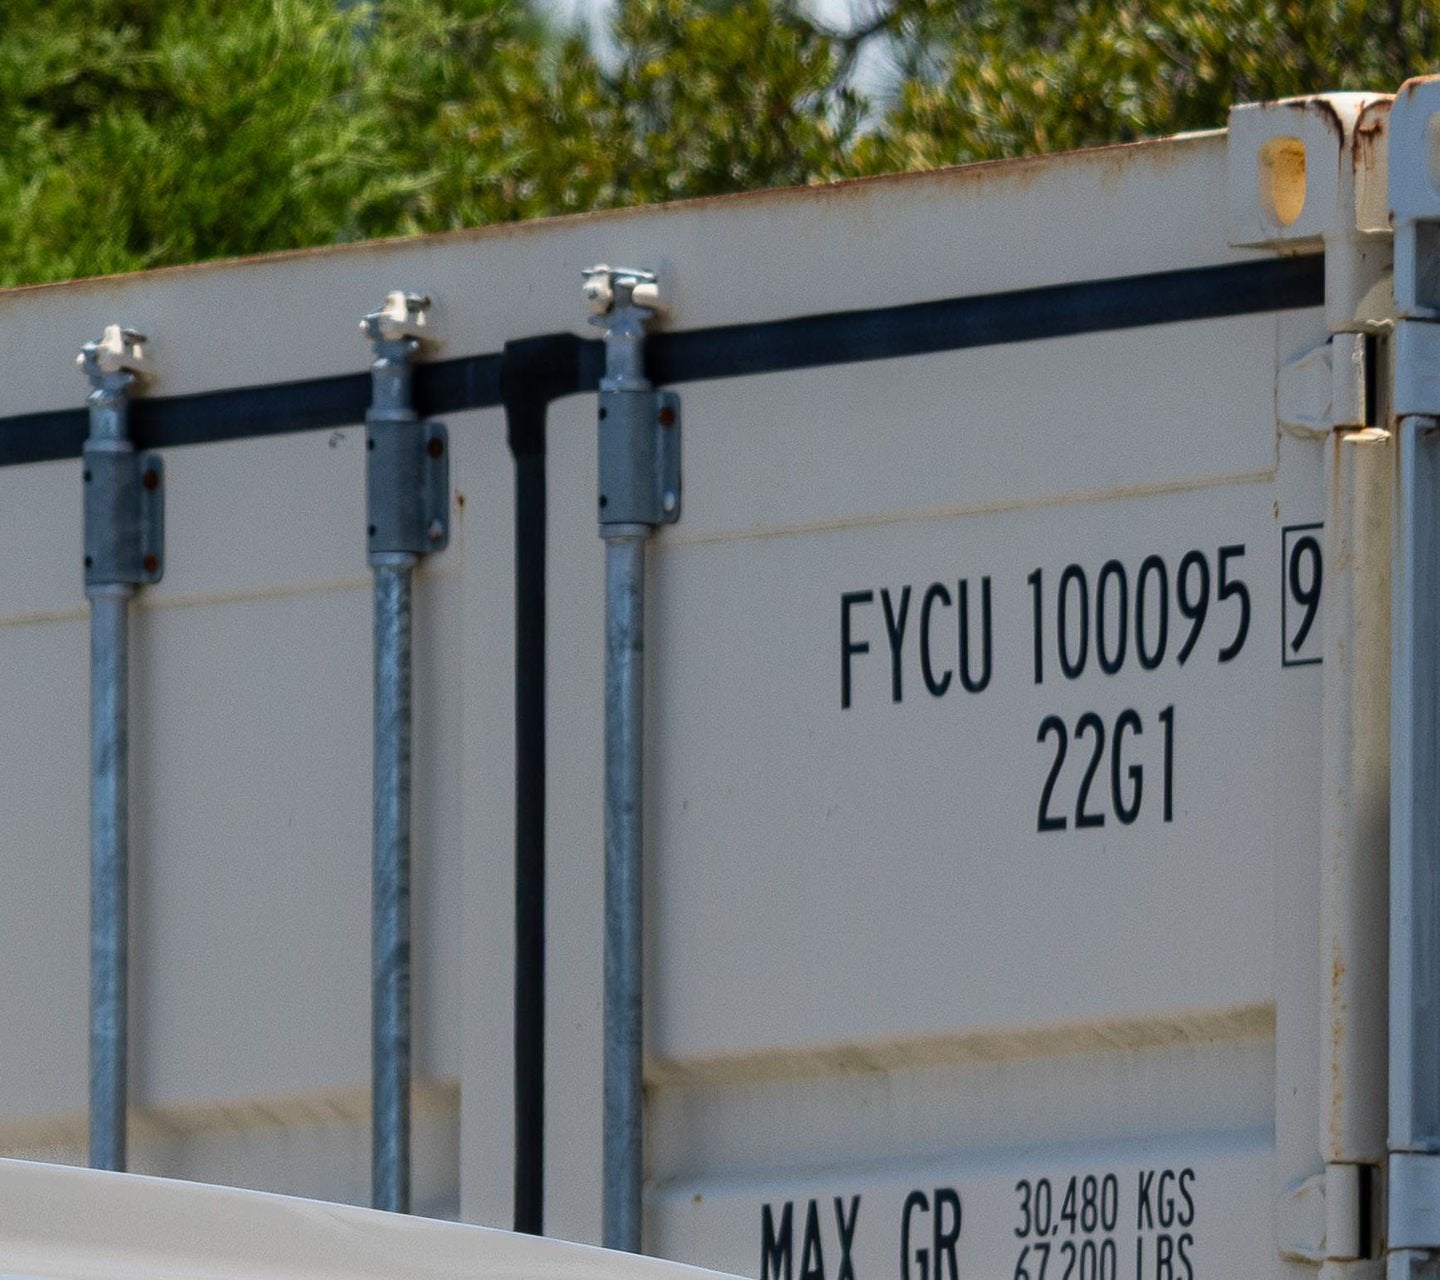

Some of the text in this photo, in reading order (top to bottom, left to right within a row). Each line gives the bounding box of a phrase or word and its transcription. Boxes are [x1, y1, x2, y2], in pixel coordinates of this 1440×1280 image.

[839, 576, 992, 710] FYCU
[1027, 543, 1251, 686] 100095
[1035, 704, 1176, 833] 22G1
[1013, 1168, 1196, 1238] 30,480 KGS
